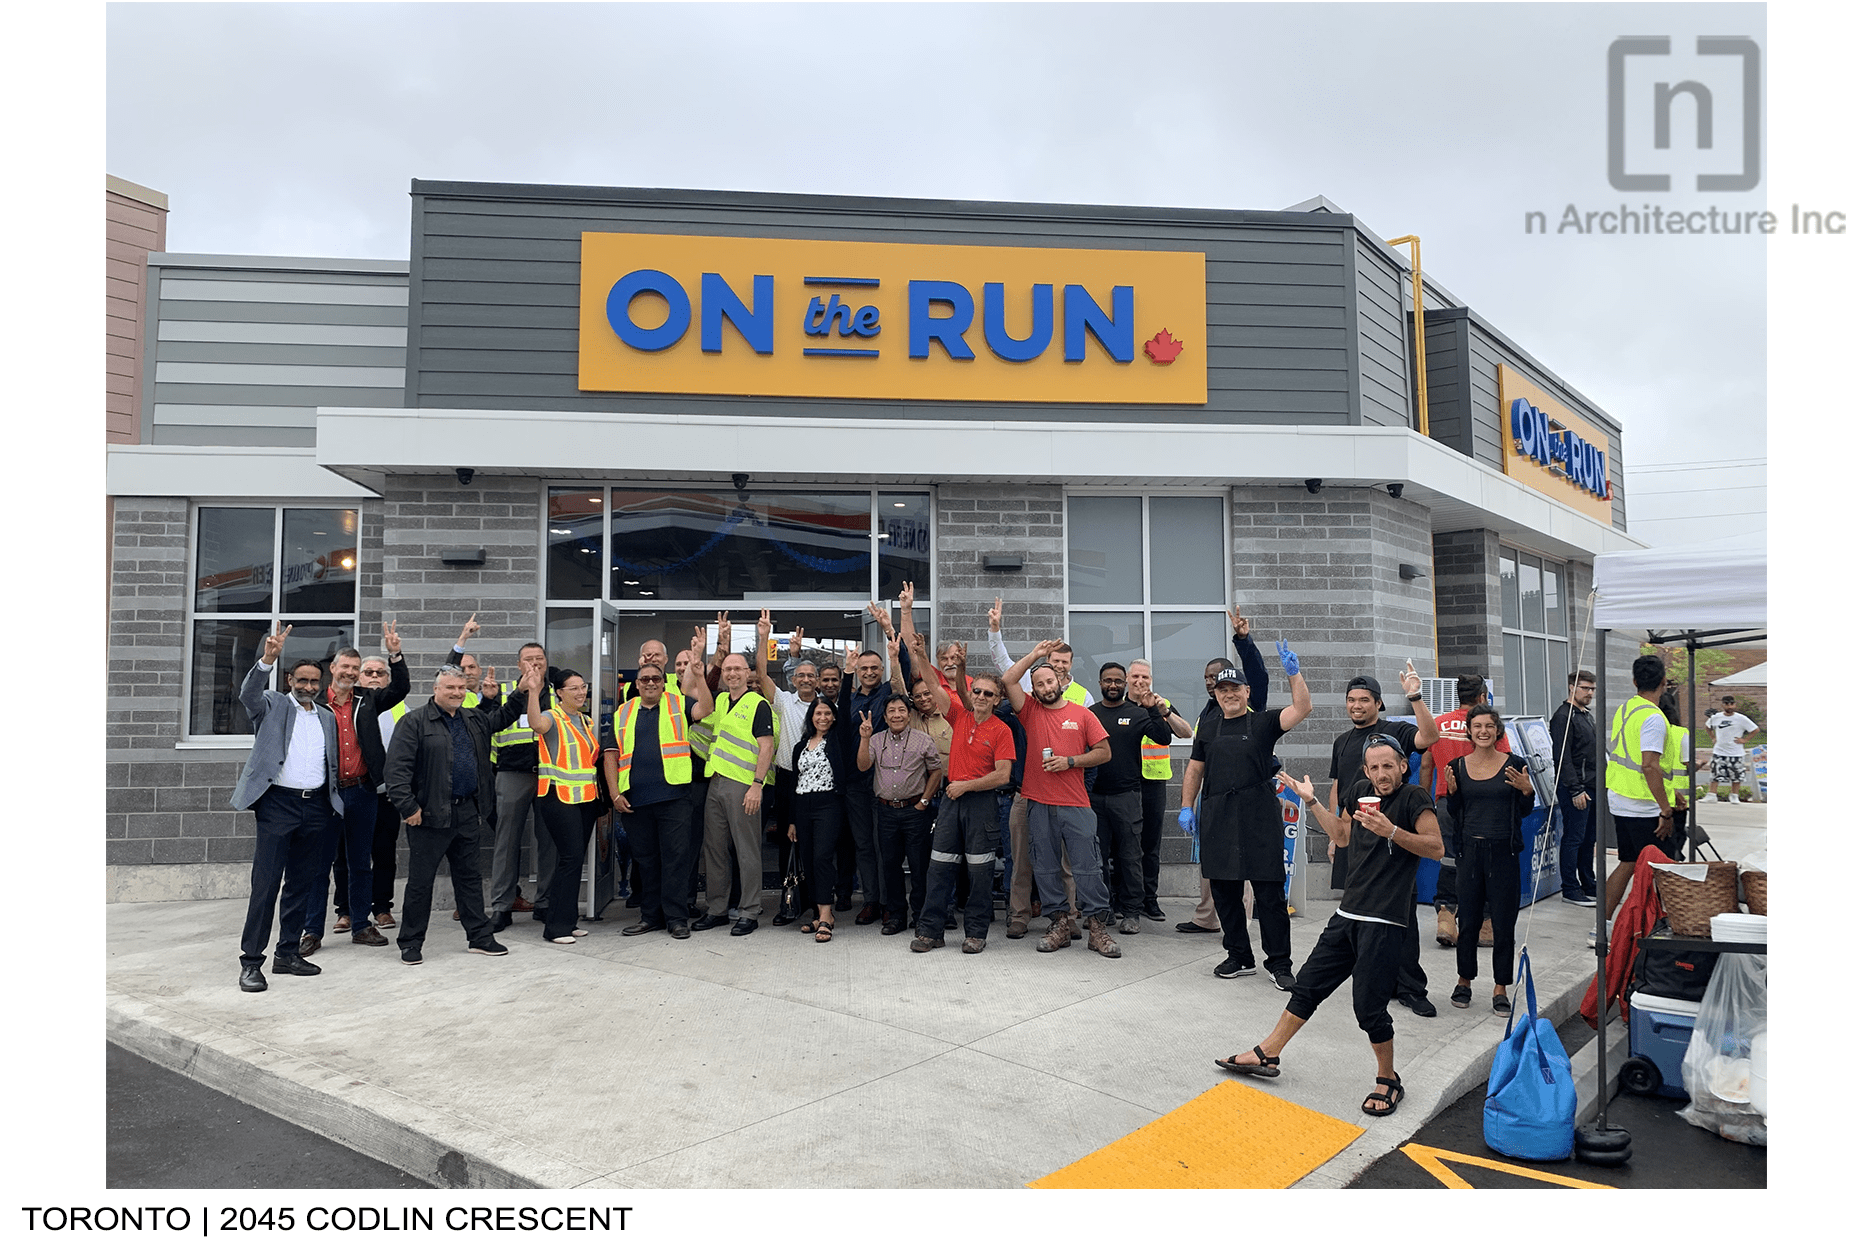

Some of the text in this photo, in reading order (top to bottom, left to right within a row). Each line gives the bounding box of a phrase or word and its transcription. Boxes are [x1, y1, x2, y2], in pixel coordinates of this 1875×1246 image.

[606, 269, 1135, 364] ON the RUN
[1511, 397, 1551, 467] ON
[1564, 430, 1607, 498] RUN
